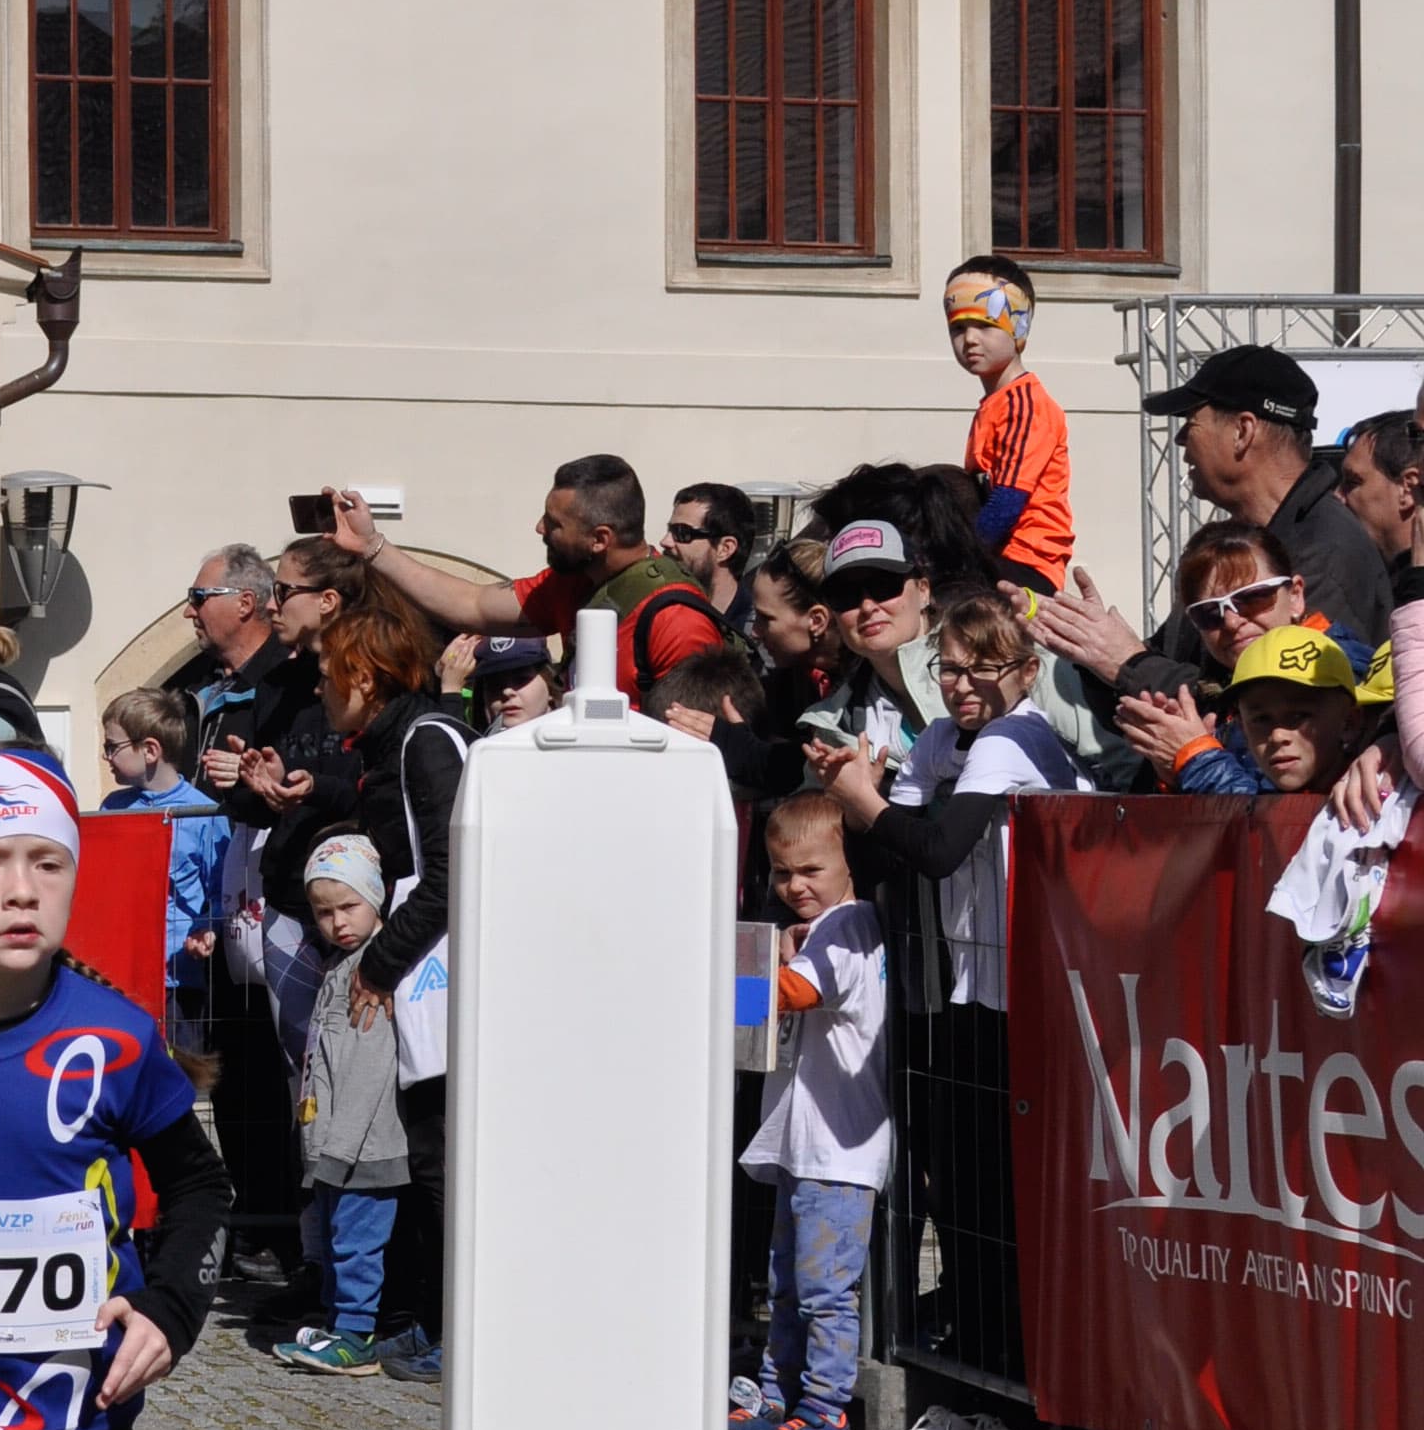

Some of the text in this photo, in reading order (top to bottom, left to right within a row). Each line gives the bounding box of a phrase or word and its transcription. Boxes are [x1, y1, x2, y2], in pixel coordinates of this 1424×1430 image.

[75, 1220, 94, 1231] run
[1140, 1236, 1231, 1283] QUALITY
[1331, 1268, 1413, 1320] SPRING
